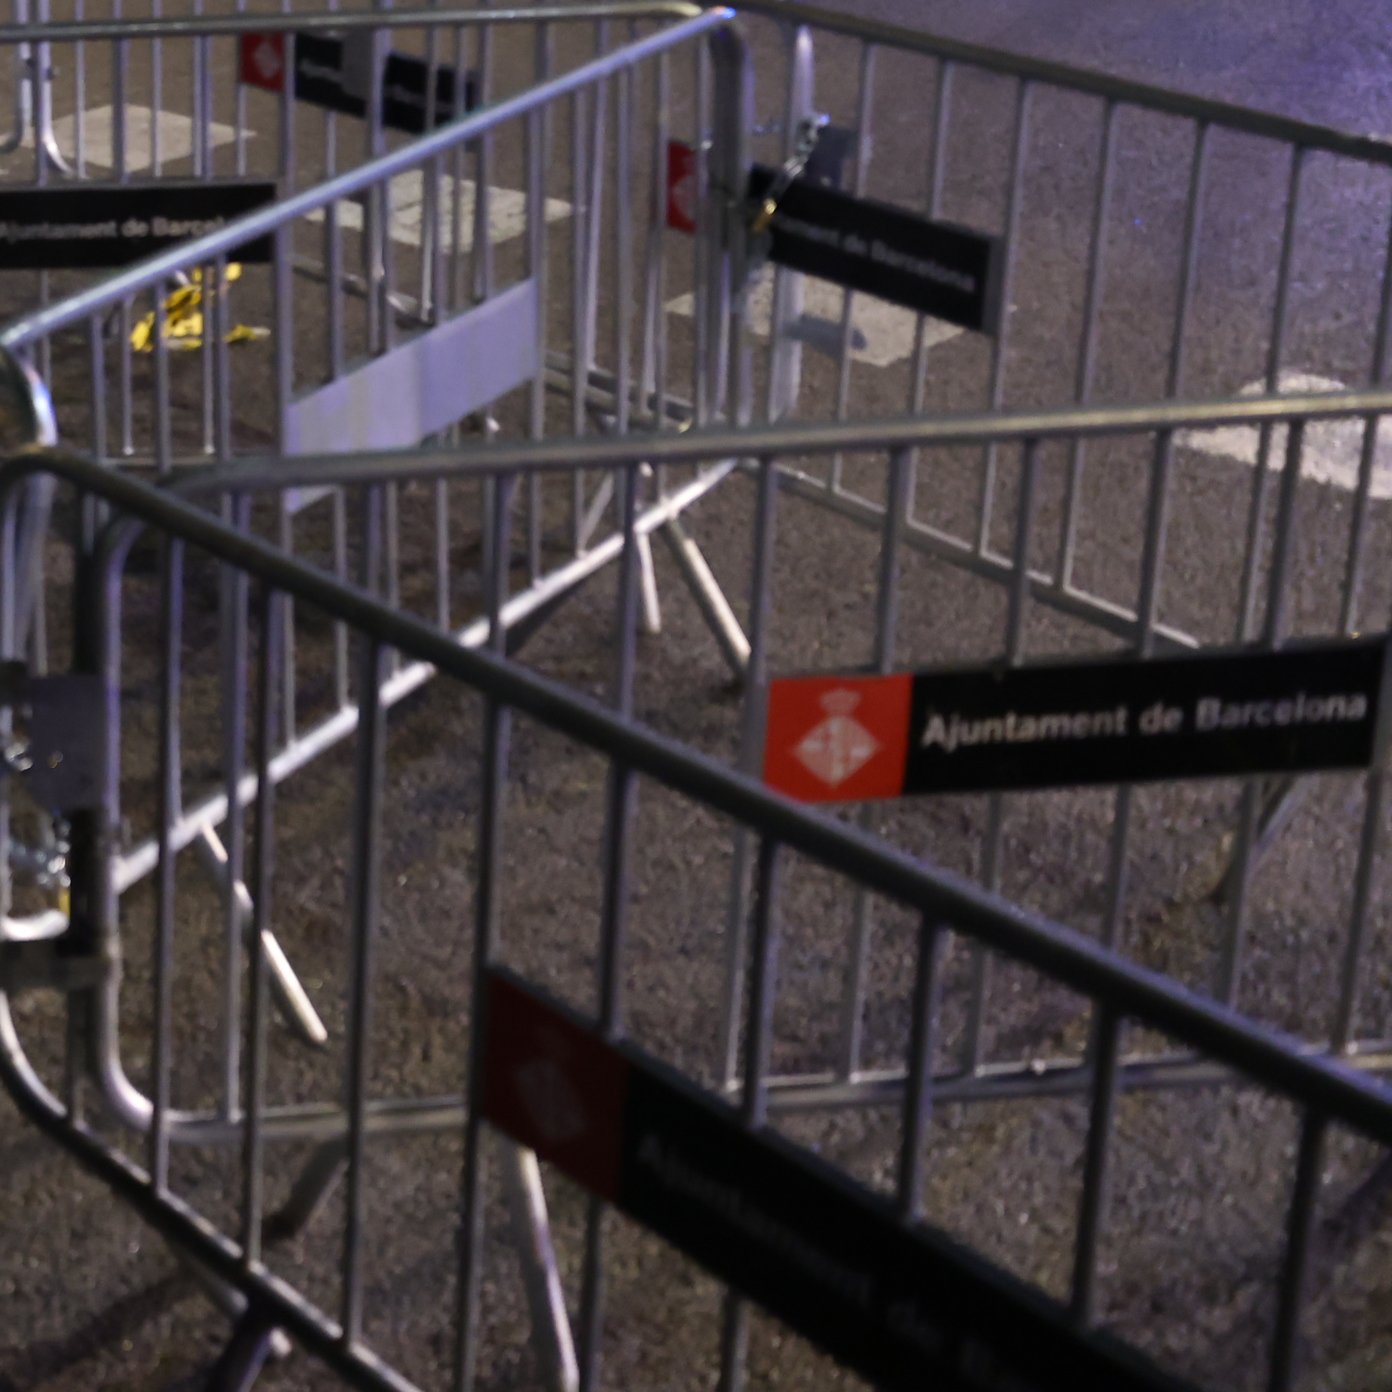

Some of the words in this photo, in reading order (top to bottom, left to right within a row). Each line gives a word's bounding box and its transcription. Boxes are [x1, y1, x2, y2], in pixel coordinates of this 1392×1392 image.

[121, 216, 149, 239] de
[151, 215, 225, 239] Barcel
[920, 701, 1129, 755] Ajuntament
[1137, 698, 1185, 737] de
[1194, 690, 1368, 734] Barcelona
